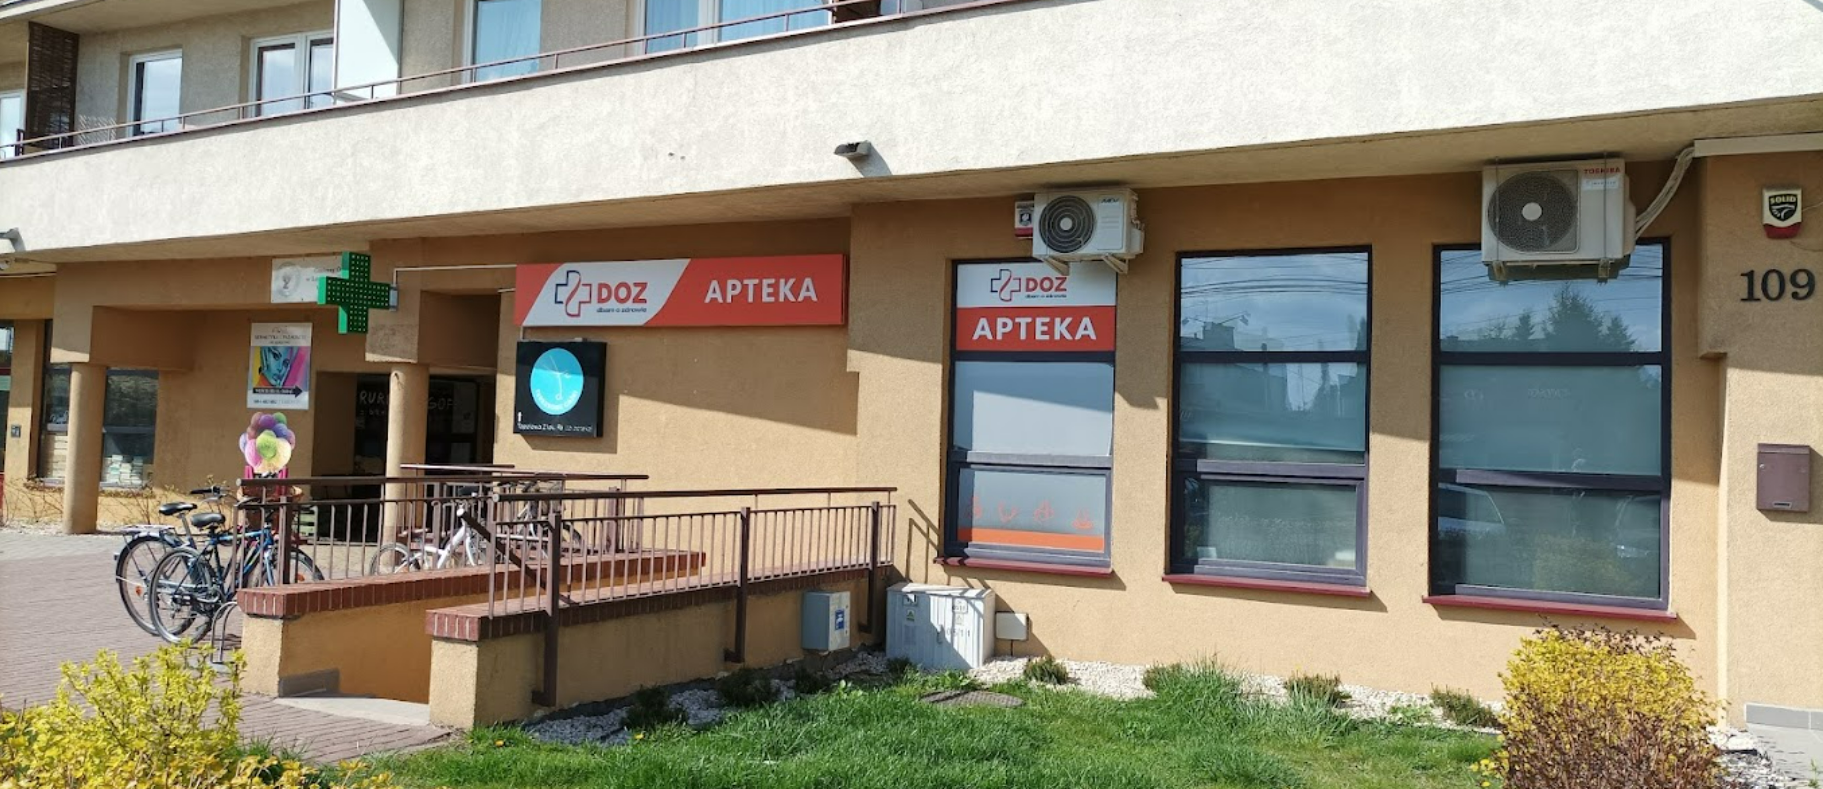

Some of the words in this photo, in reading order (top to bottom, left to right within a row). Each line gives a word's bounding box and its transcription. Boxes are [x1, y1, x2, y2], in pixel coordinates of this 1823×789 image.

[1770, 195, 1796, 204] SOLID
[596, 281, 648, 304] DOZ
[704, 277, 818, 304] APTEKA
[1025, 276, 1067, 293] DOZ
[1740, 268, 1816, 303] 109
[972, 317, 1097, 341] APTEKA
